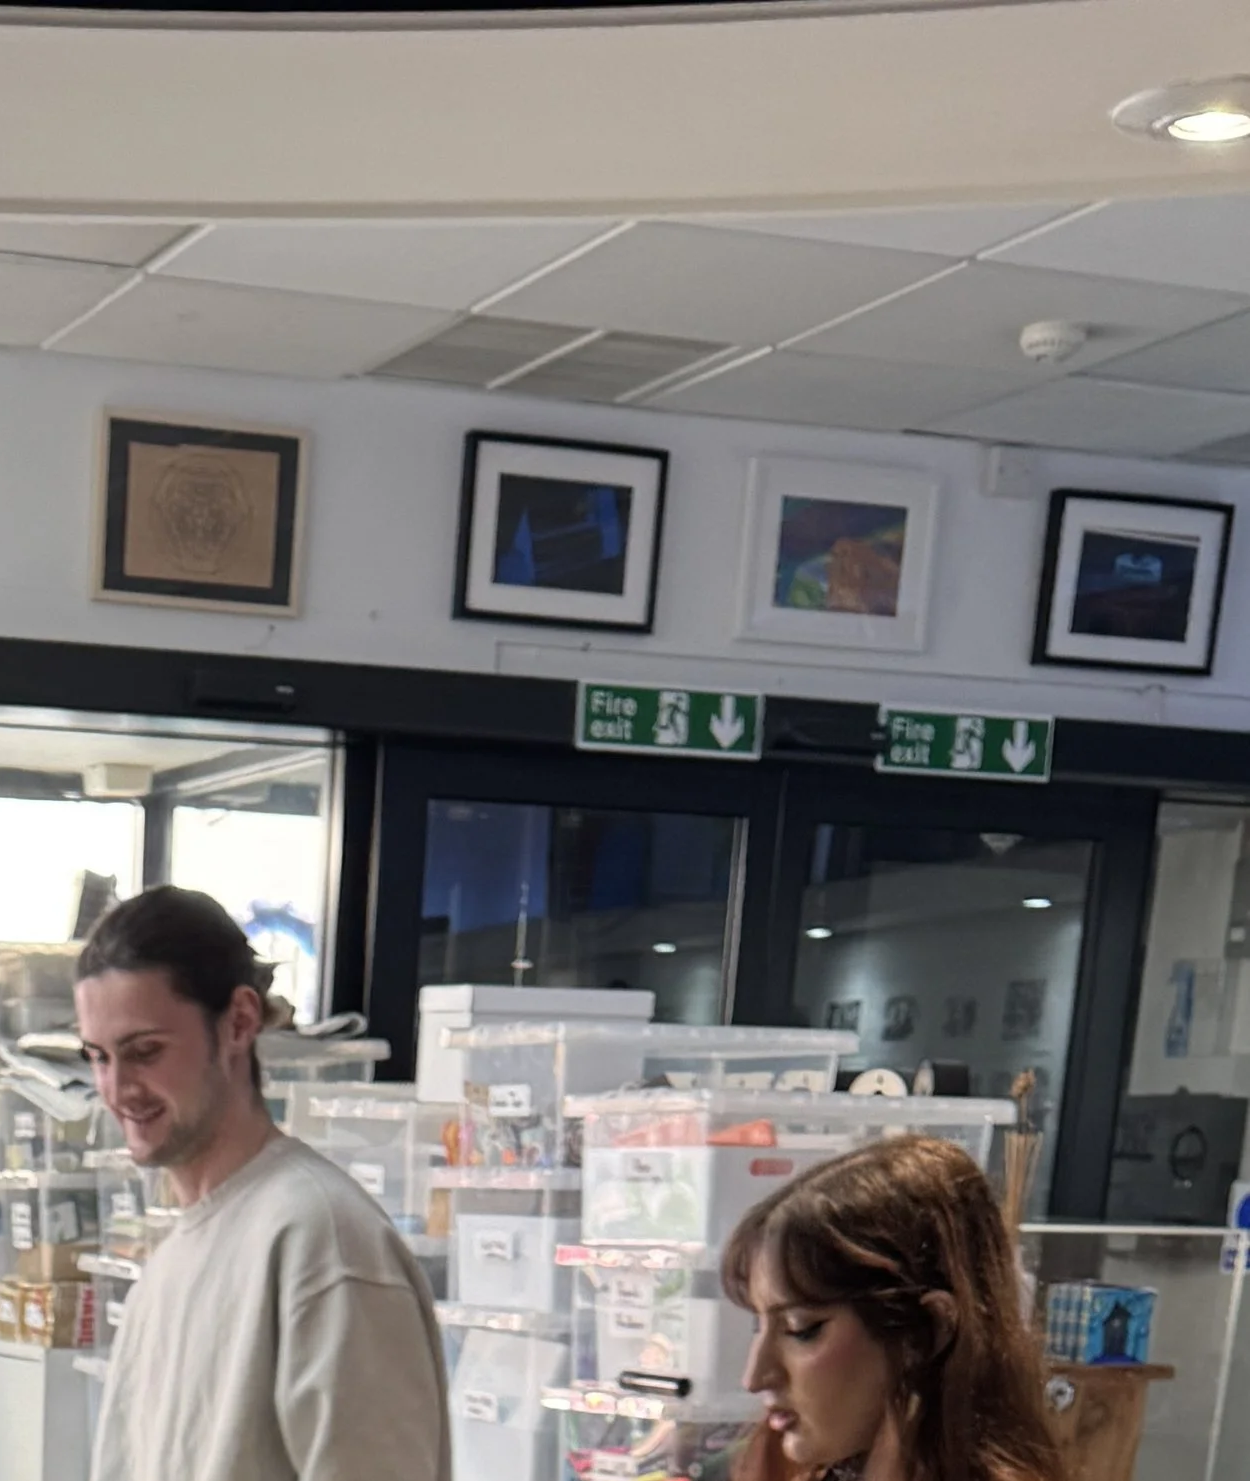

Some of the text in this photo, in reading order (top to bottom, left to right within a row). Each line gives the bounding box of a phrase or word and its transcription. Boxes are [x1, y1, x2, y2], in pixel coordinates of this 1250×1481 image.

[590, 690, 639, 717] Fire
[589, 716, 633, 741] exit
[891, 716, 936, 742] Fire
[890, 741, 931, 765] exit
